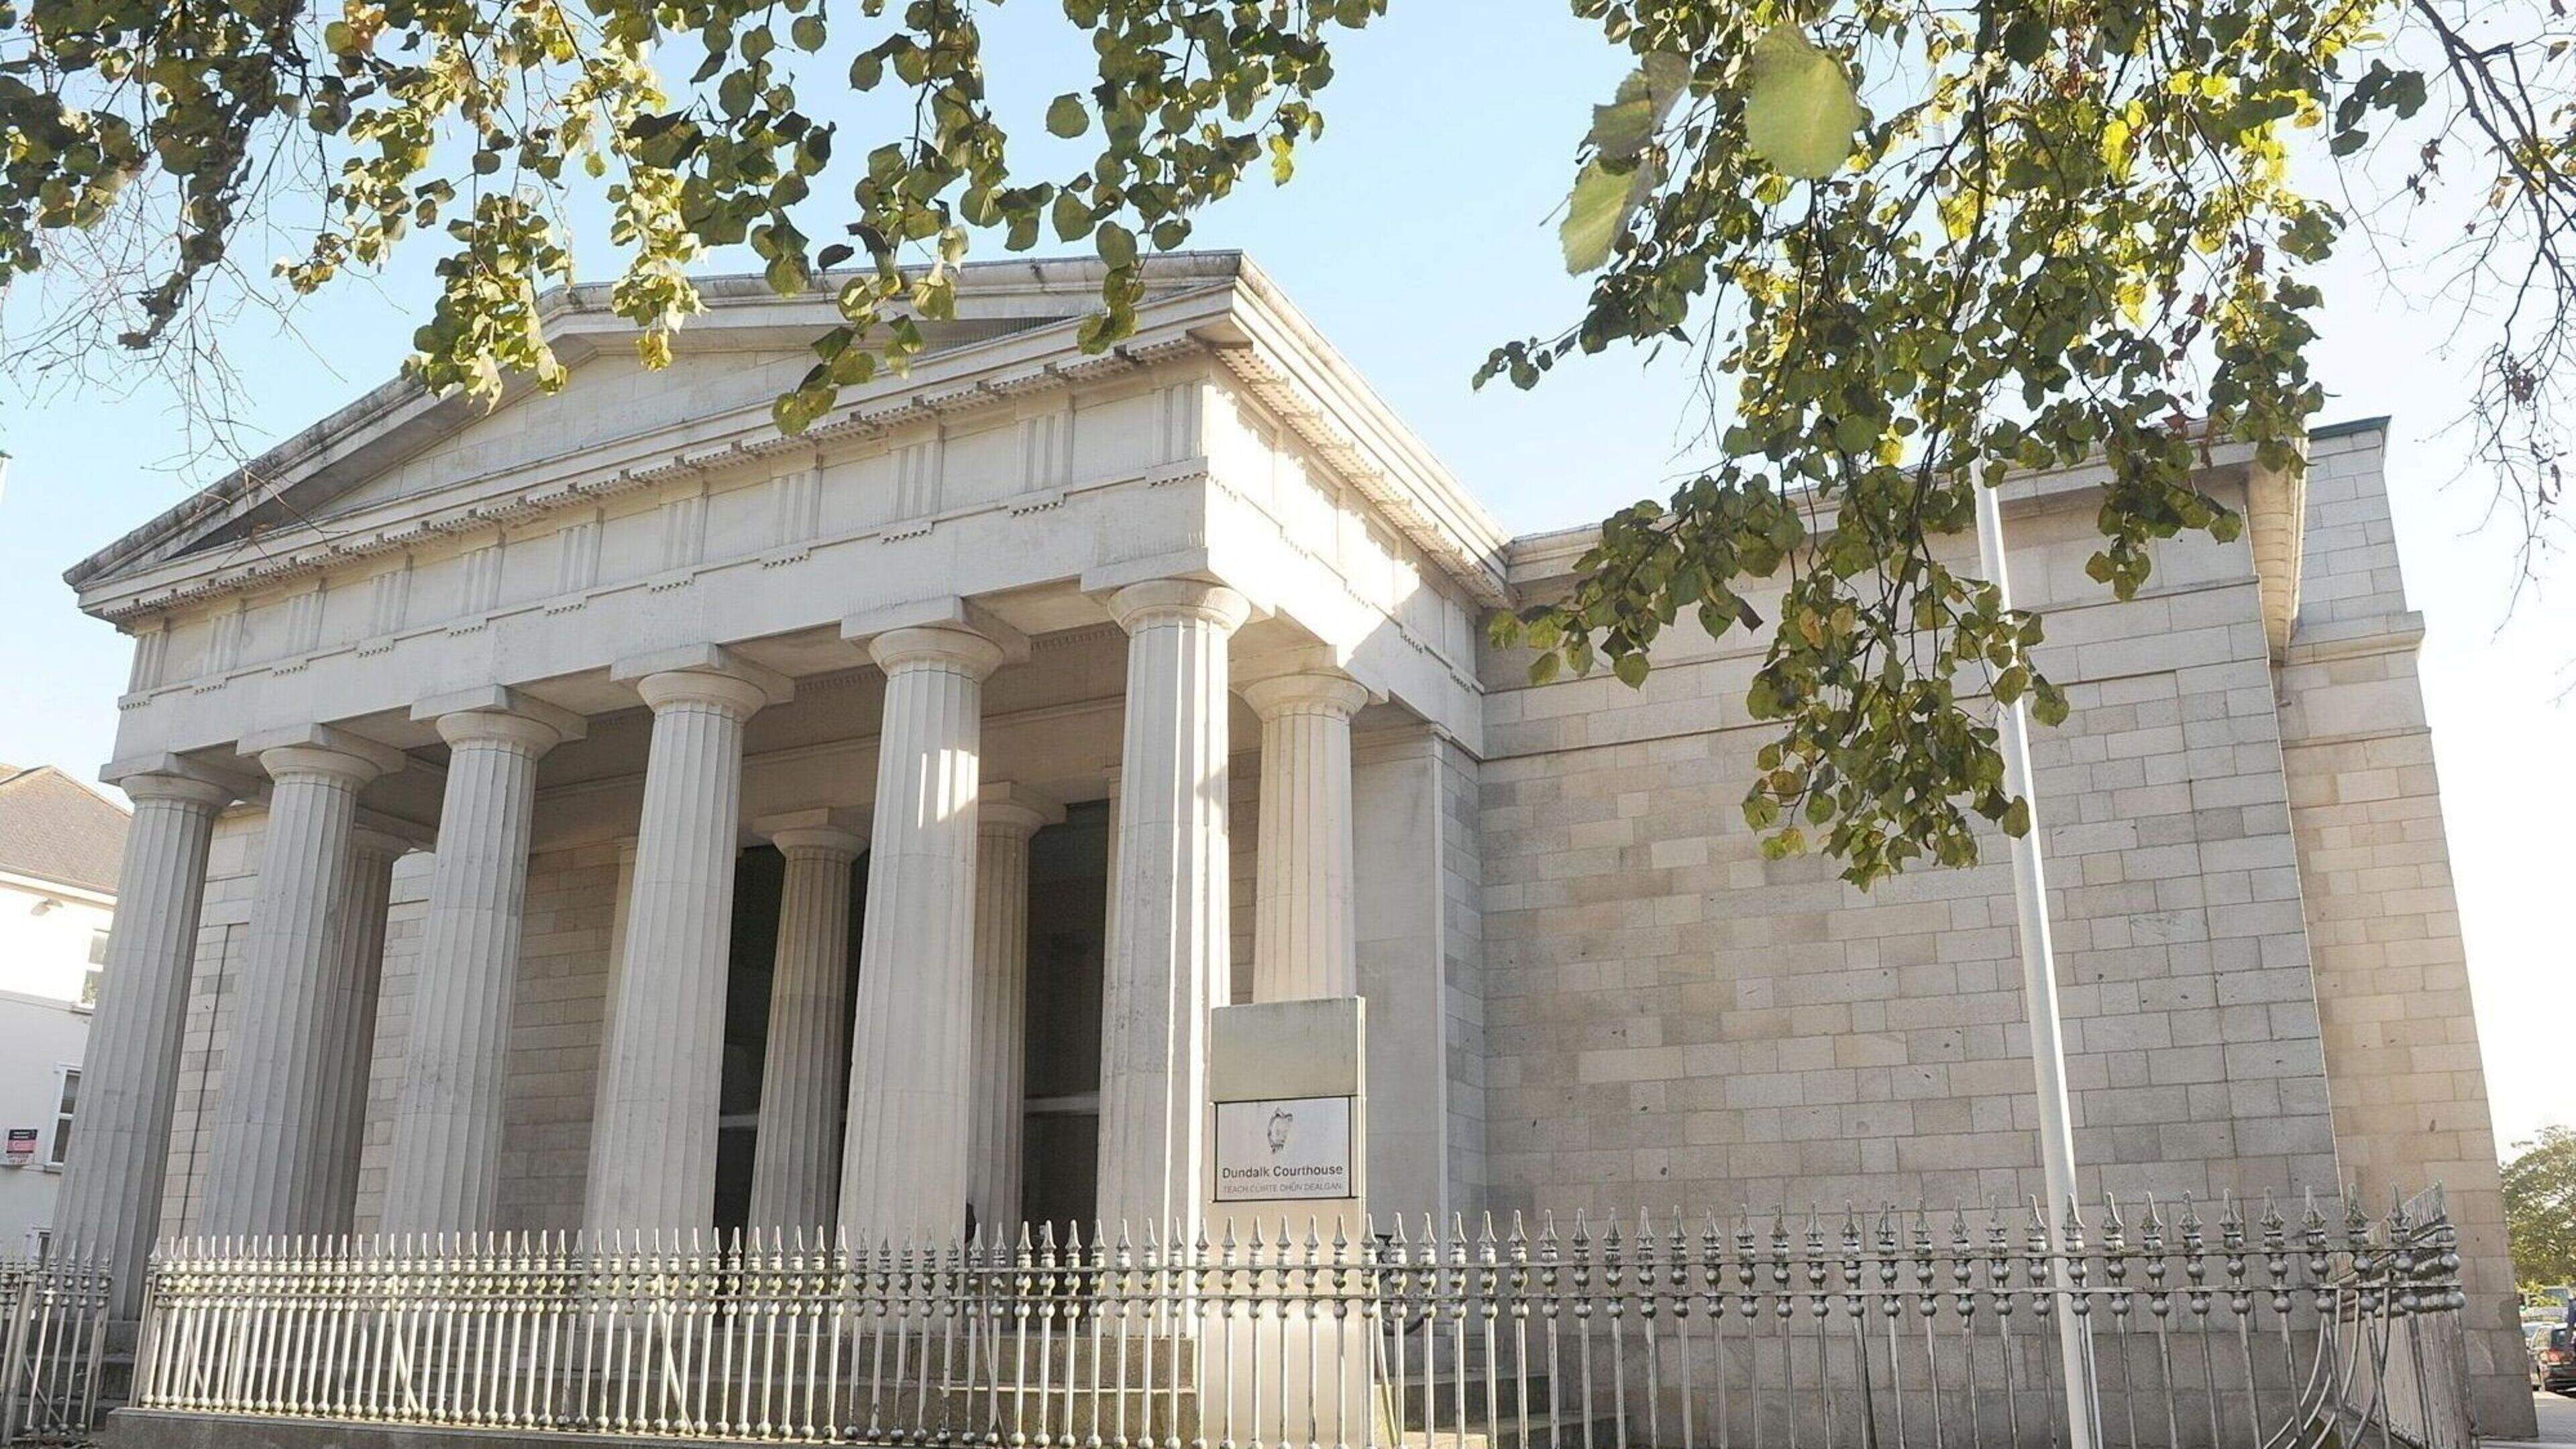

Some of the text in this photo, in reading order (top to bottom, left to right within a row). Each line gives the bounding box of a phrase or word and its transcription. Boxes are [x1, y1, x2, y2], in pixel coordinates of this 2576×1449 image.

[1222, 1165, 1343, 1179] Dundalk Courthouse
[1224, 1184, 1248, 1193] TEACH
